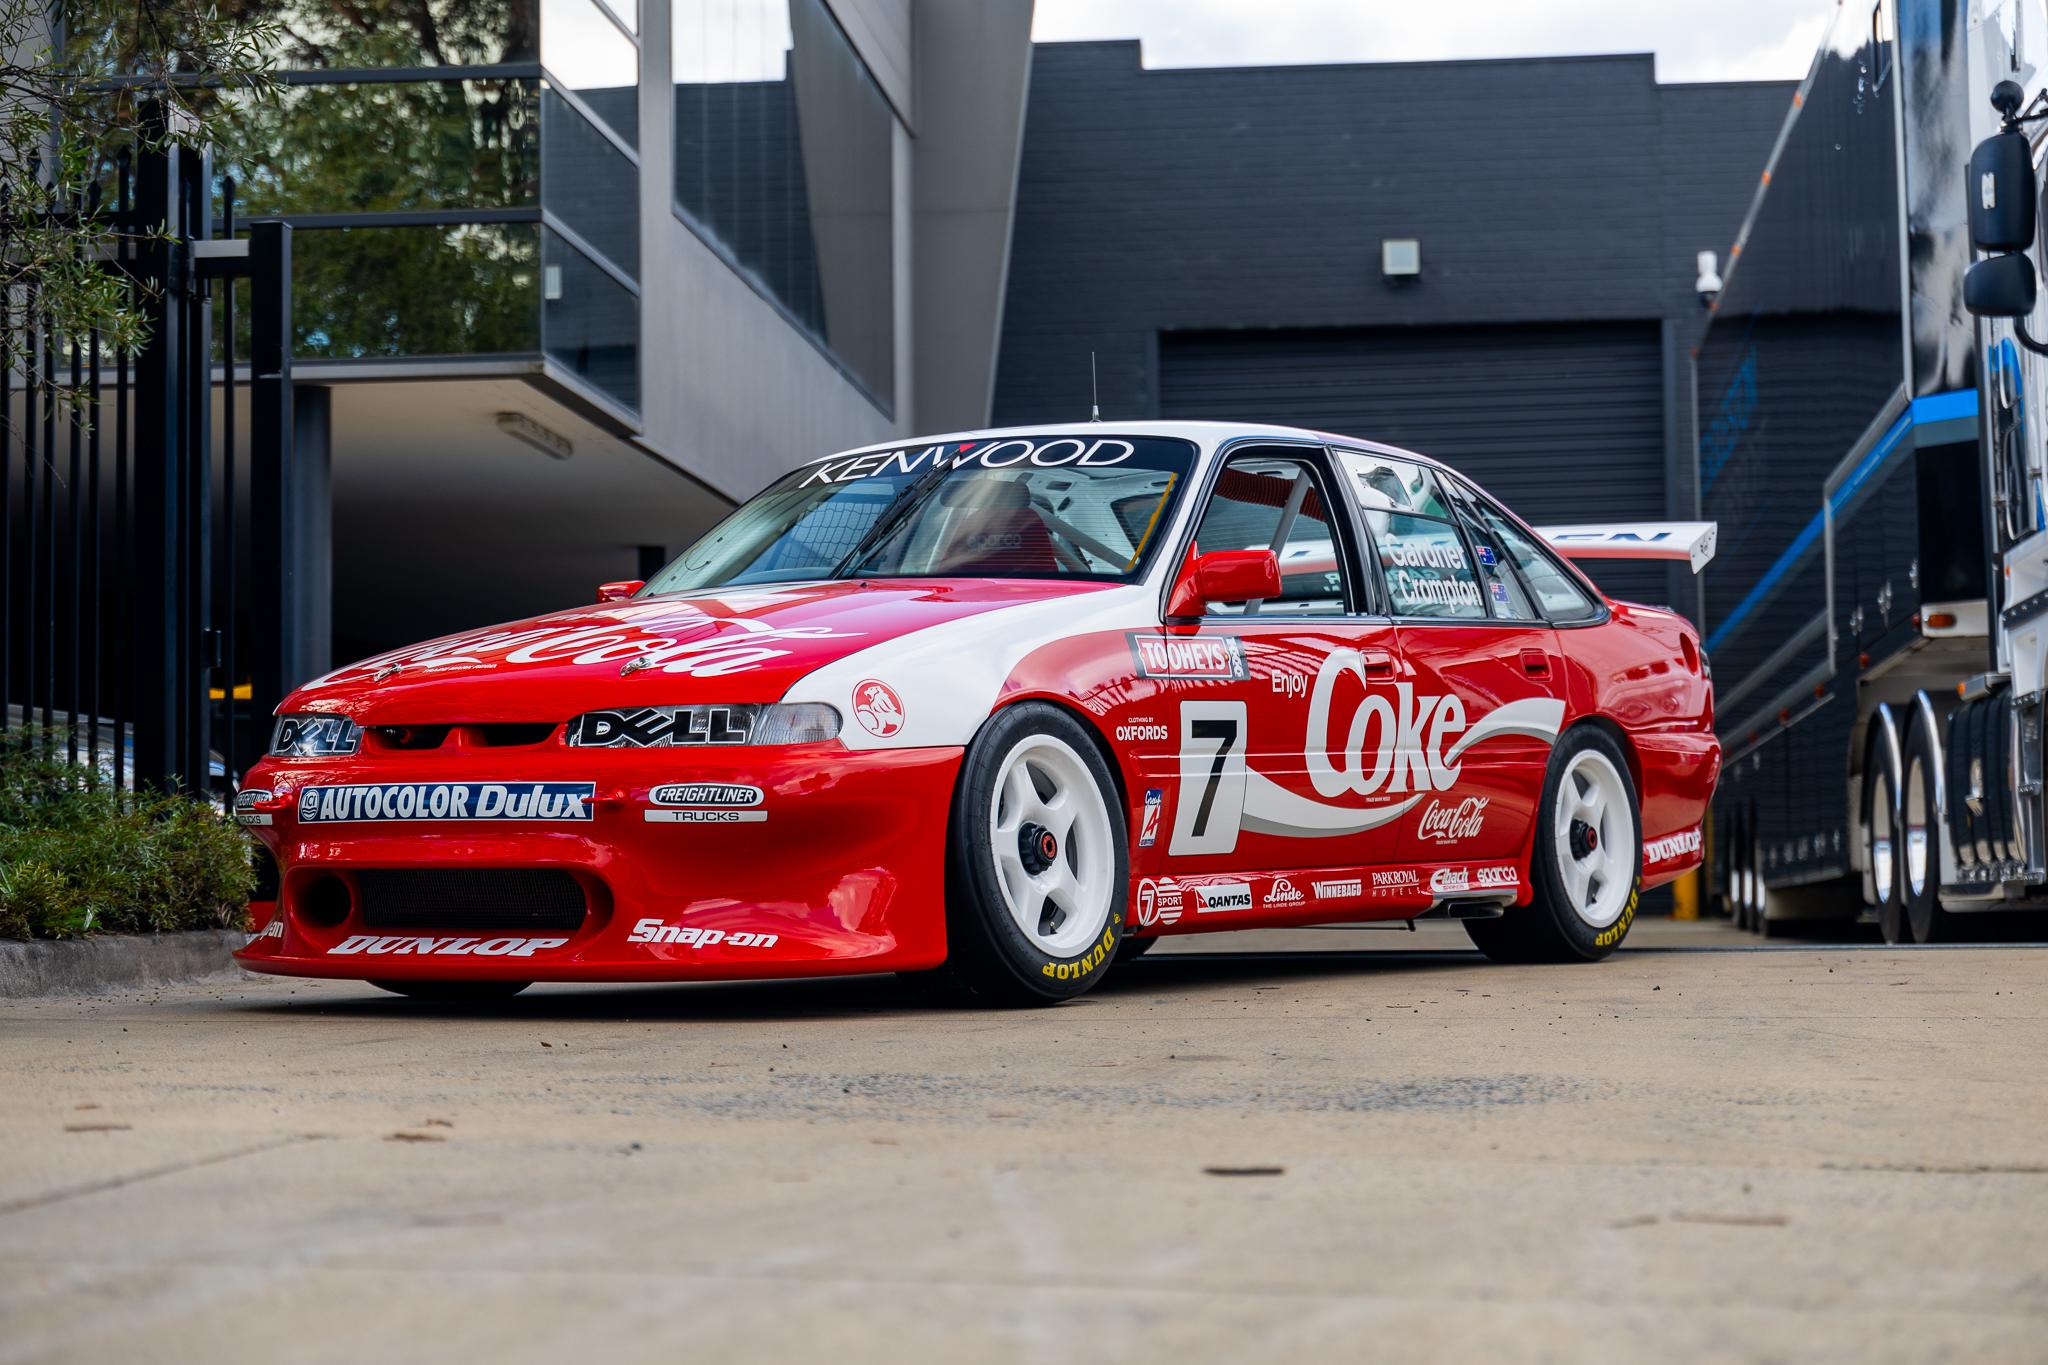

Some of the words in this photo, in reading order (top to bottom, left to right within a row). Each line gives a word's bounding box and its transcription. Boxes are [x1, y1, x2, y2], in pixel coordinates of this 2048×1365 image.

[798, 439, 1134, 489] KENWOOD
[1385, 533, 1467, 569] Gardner
[1398, 570, 1483, 613] Crompton
[1142, 642, 1226, 670] TOOHEYS
[1272, 670, 1308, 698] Enjoy
[275, 716, 356, 753] DELL
[578, 707, 746, 747] DELL
[1116, 725, 1168, 740] OXFORDS
[1304, 650, 1466, 797] Coke
[1191, 720, 1237, 837] 7
[304, 795, 316, 807] ICI
[320, 785, 470, 820] AUTOCOLOR
[475, 785, 592, 818] Dulux
[658, 787, 754, 802] FREIGHTLINER
[672, 811, 739, 821] TRUCKS
[1417, 797, 1490, 840] Coca-Cola
[1647, 830, 1702, 863] DUNLOP
[1312, 879, 1361, 899] WINNEBAGO
[1372, 870, 1419, 886] PARKROYAL
[1477, 866, 1518, 885] sparco
[1157, 896, 1182, 906] SPORT
[1208, 893, 1250, 908] QANTAS
[1264, 879, 1304, 902] Linde
[1595, 888, 1638, 946] DUNLOP
[327, 936, 569, 957] DUNLOP
[627, 918, 779, 949] Snap-on
[1042, 926, 1115, 980] DUNLOP
